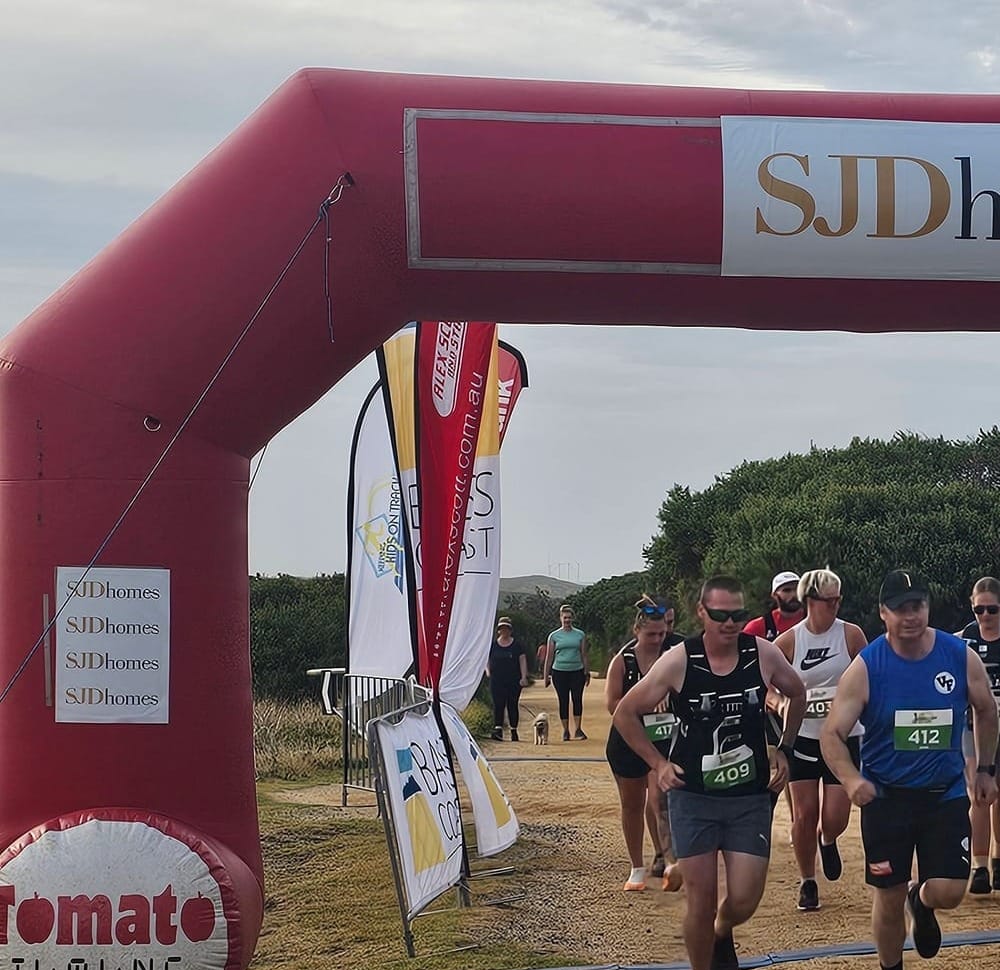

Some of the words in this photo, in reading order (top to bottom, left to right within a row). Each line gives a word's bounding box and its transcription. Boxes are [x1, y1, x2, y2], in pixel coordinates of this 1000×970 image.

[433, 354, 449, 400] ALEX
[388, 513, 399, 537] ON
[908, 729, 940, 744] 412
[714, 763, 750, 784] 409
